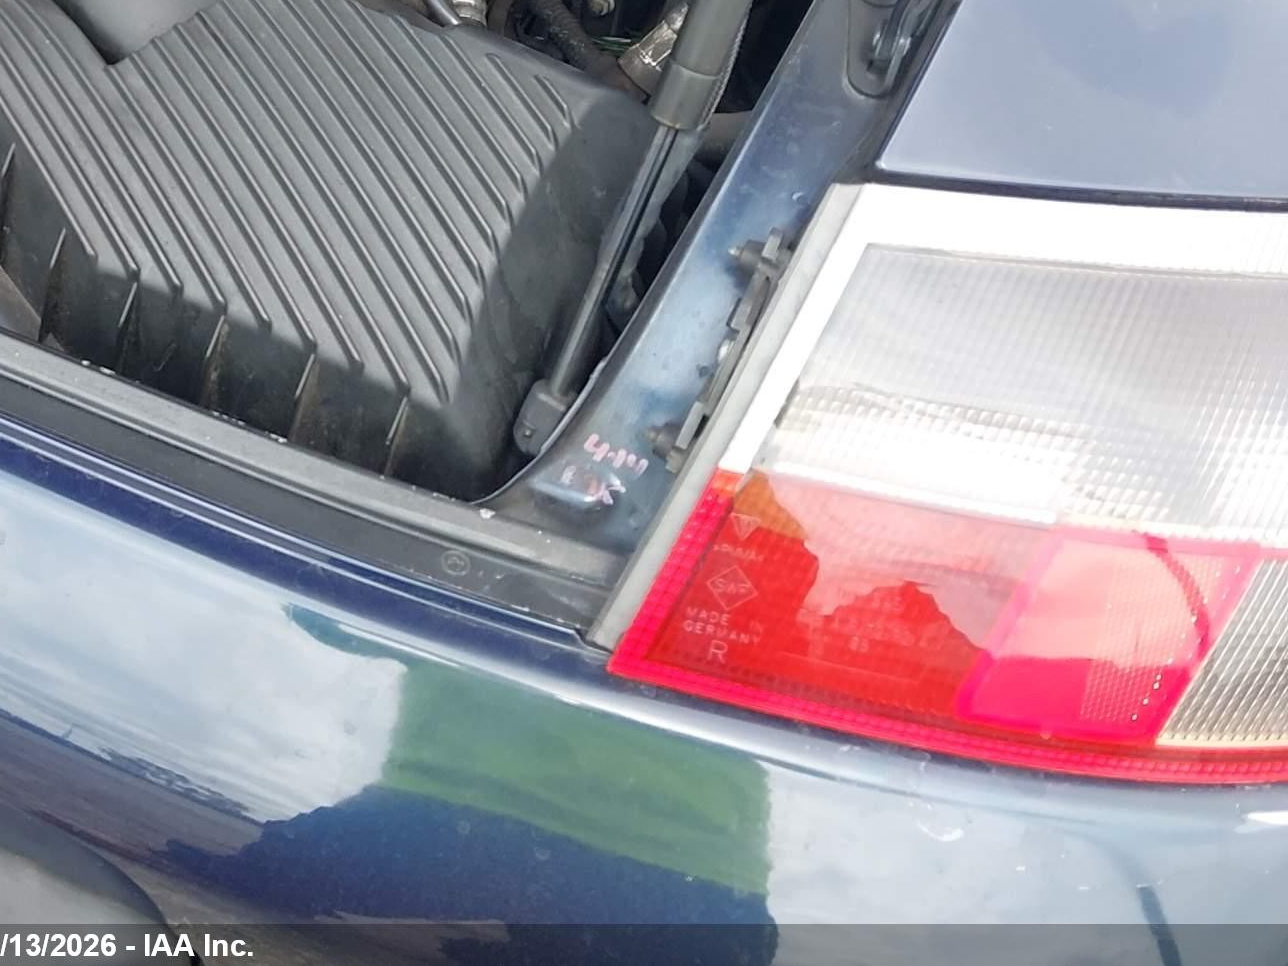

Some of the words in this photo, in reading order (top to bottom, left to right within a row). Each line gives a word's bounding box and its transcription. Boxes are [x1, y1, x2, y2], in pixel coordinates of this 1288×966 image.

[686, 606, 730, 626] MADE
[683, 619, 761, 644] GERMANY
[708, 640, 728, 664] R
